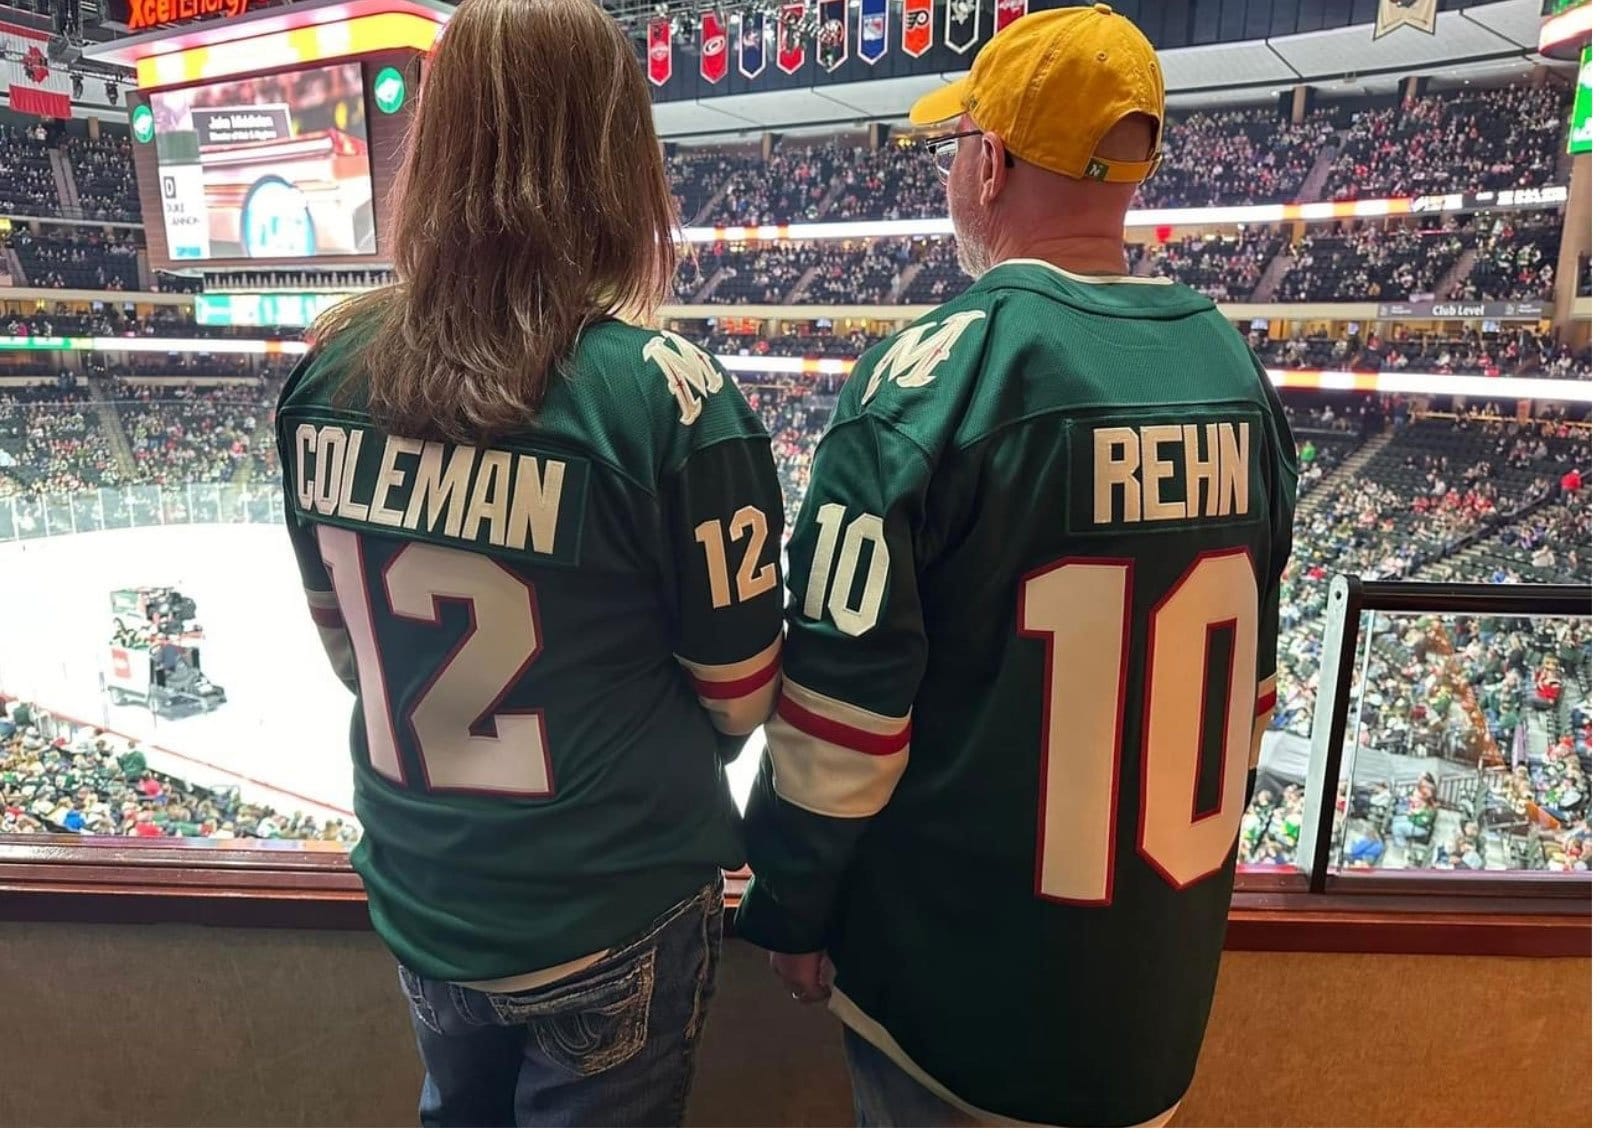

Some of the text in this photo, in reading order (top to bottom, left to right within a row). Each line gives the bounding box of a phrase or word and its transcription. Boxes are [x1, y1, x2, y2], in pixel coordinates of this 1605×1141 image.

[1431, 305, 1485, 316] Club Level
[294, 423, 568, 555] COLEMAN
[1093, 422, 1250, 524] REHN
[694, 505, 778, 610] 12
[803, 502, 889, 637] 10
[315, 524, 556, 798] 12
[1017, 550, 1258, 908] 10
